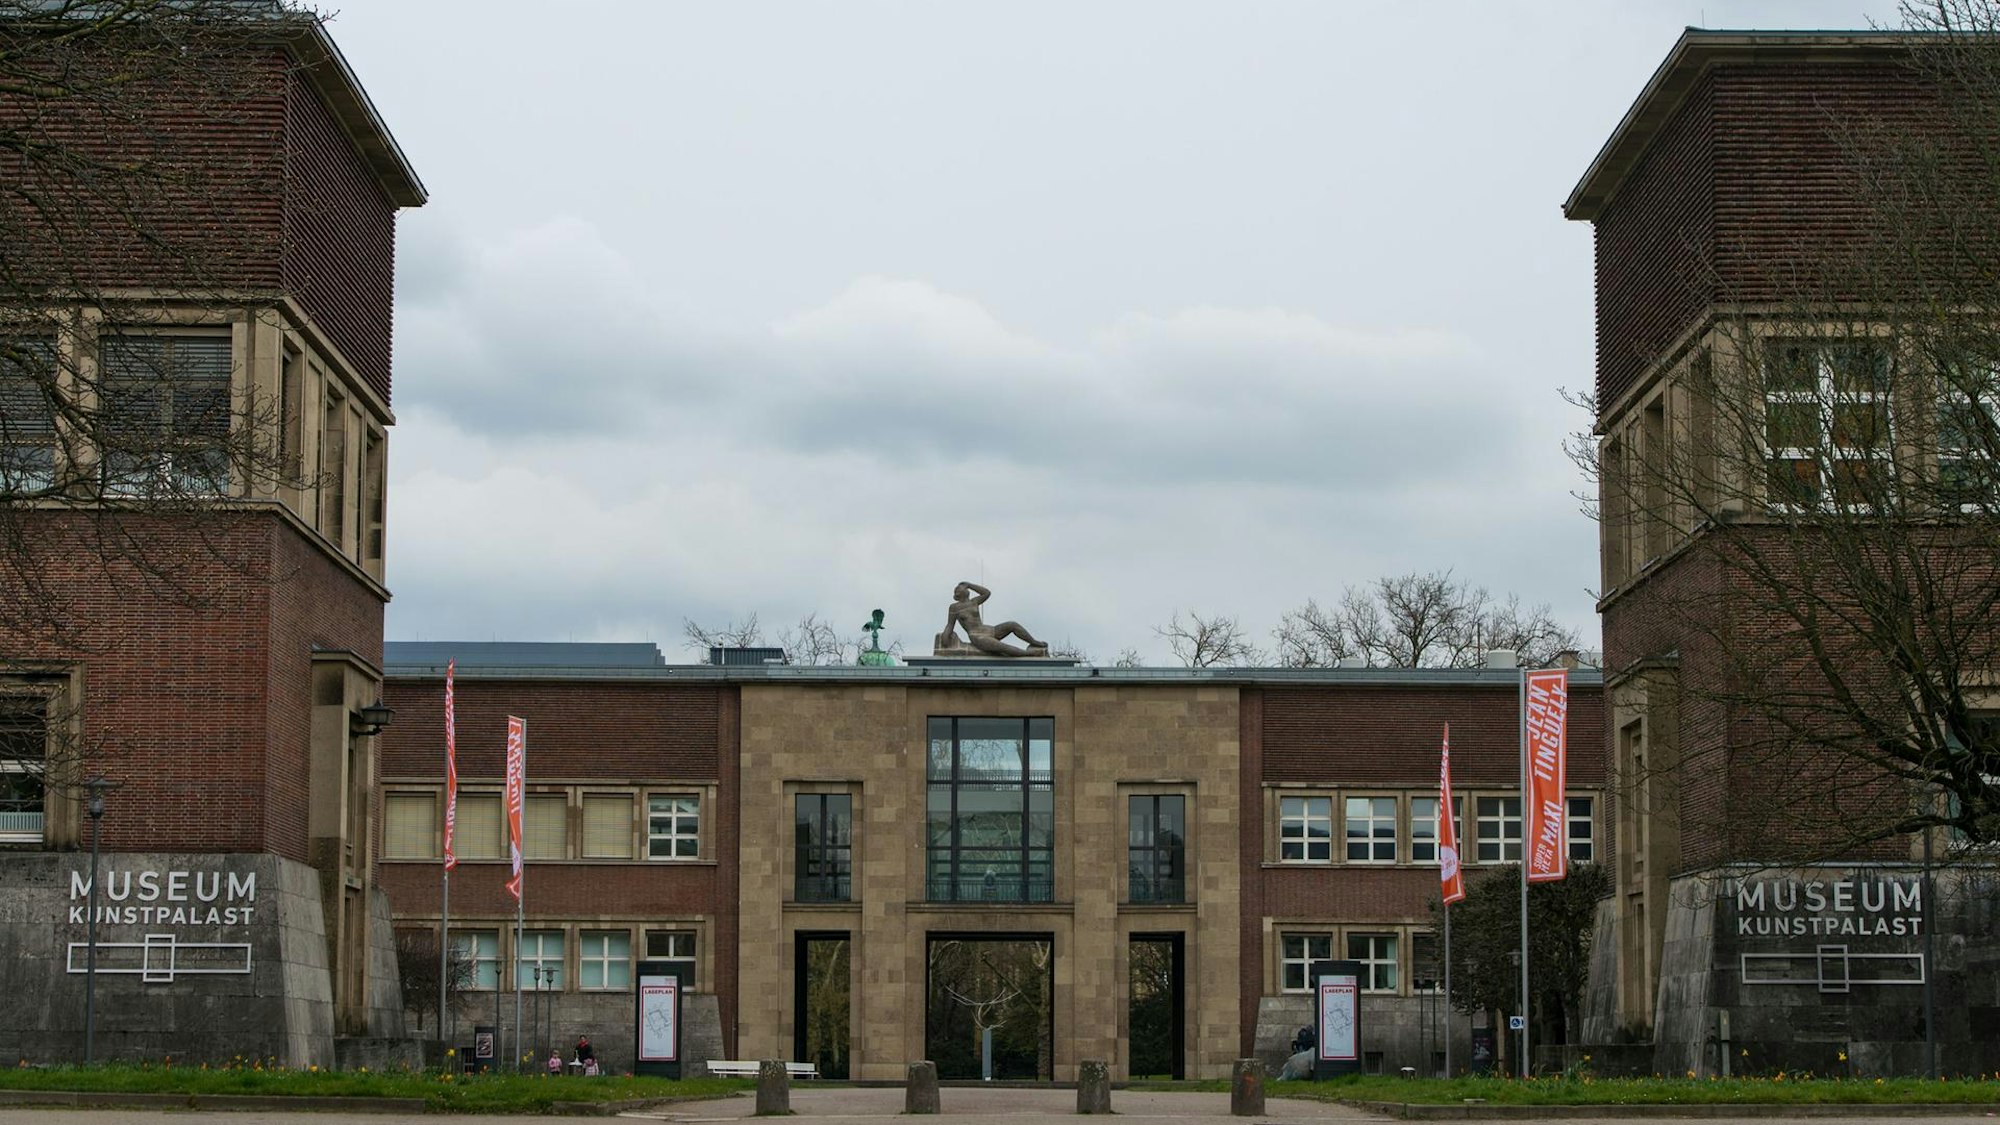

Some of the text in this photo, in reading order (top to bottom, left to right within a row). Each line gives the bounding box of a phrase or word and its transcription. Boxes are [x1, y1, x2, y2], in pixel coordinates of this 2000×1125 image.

[1527, 685, 1549, 740] JEAN
[1534, 684, 1568, 782] TINGUELY
[1541, 800, 1563, 847] MAXI
[1534, 844, 1546, 868] SUPER
[1540, 849, 1554, 874] META
[70, 871, 256, 902] MUSEUM
[1737, 881, 1922, 913] MUSEUM
[69, 906, 255, 925] KUNSTPALAST
[1738, 917, 1923, 936] KUNSTPALAST
